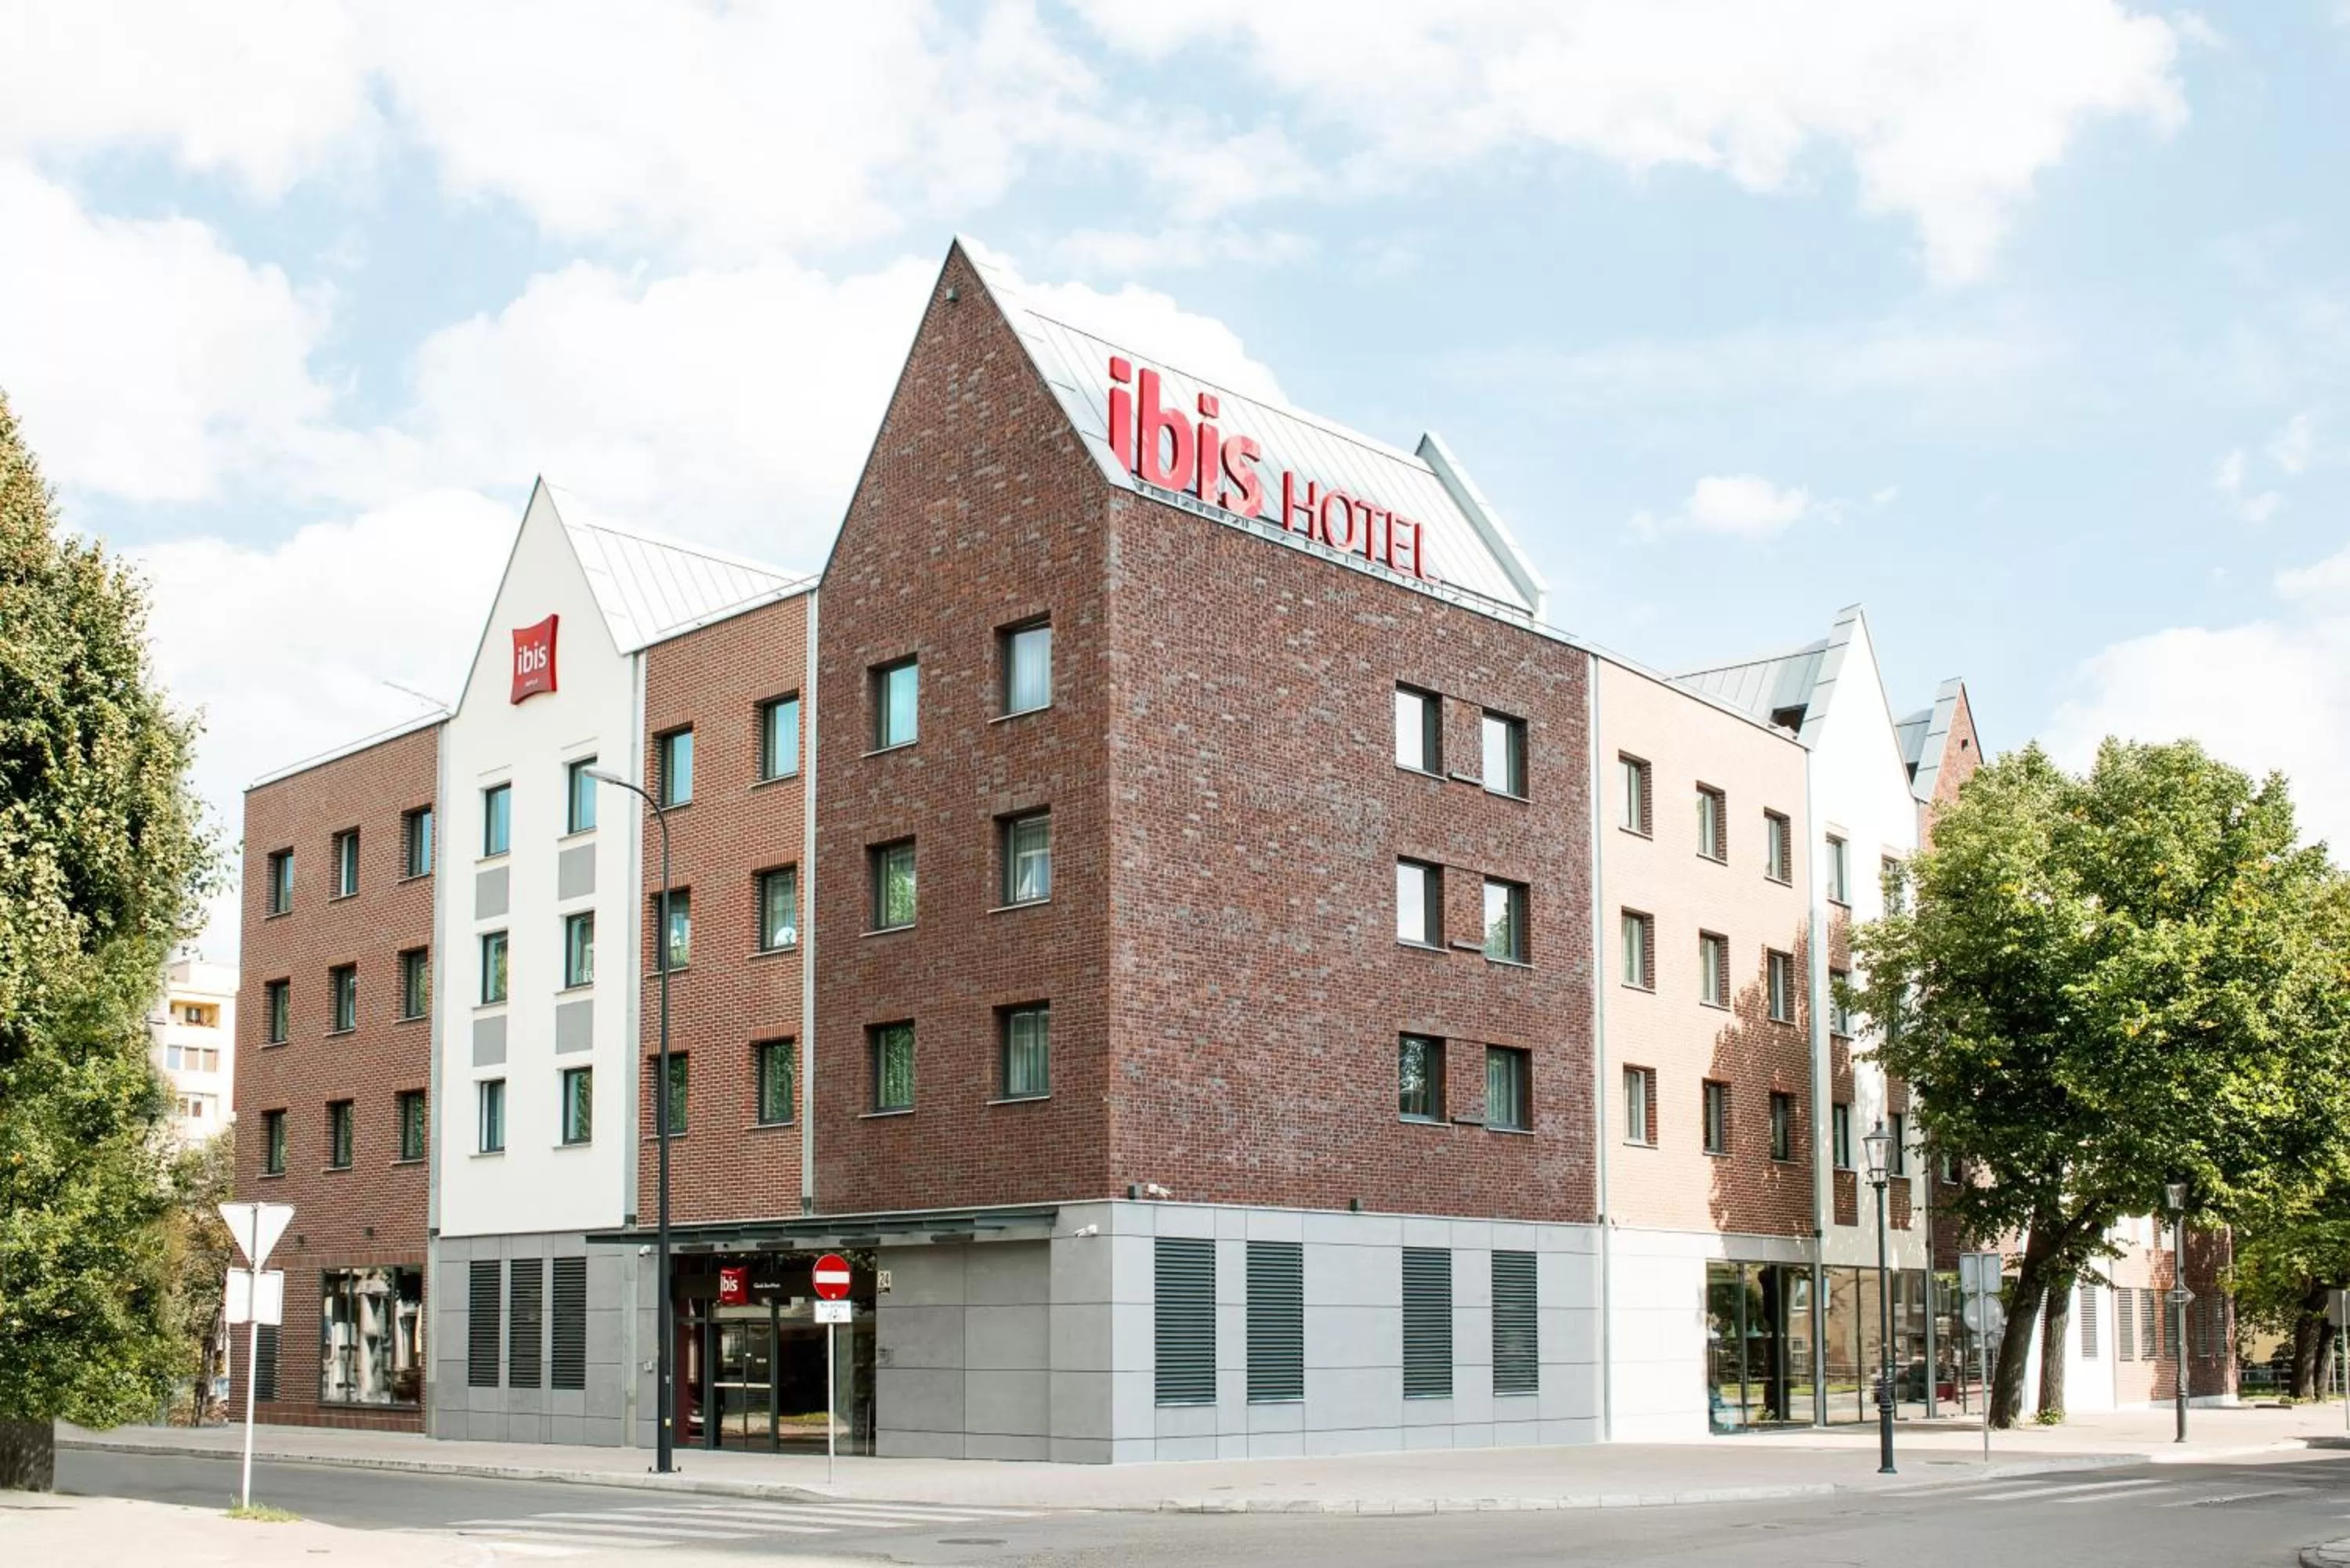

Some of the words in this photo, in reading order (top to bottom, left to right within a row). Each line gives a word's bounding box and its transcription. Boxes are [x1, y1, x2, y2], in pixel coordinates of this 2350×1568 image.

[1108, 356, 1264, 518] ibis
[1282, 470, 1440, 584] HOTEL
[518, 641, 547, 675] ibis
